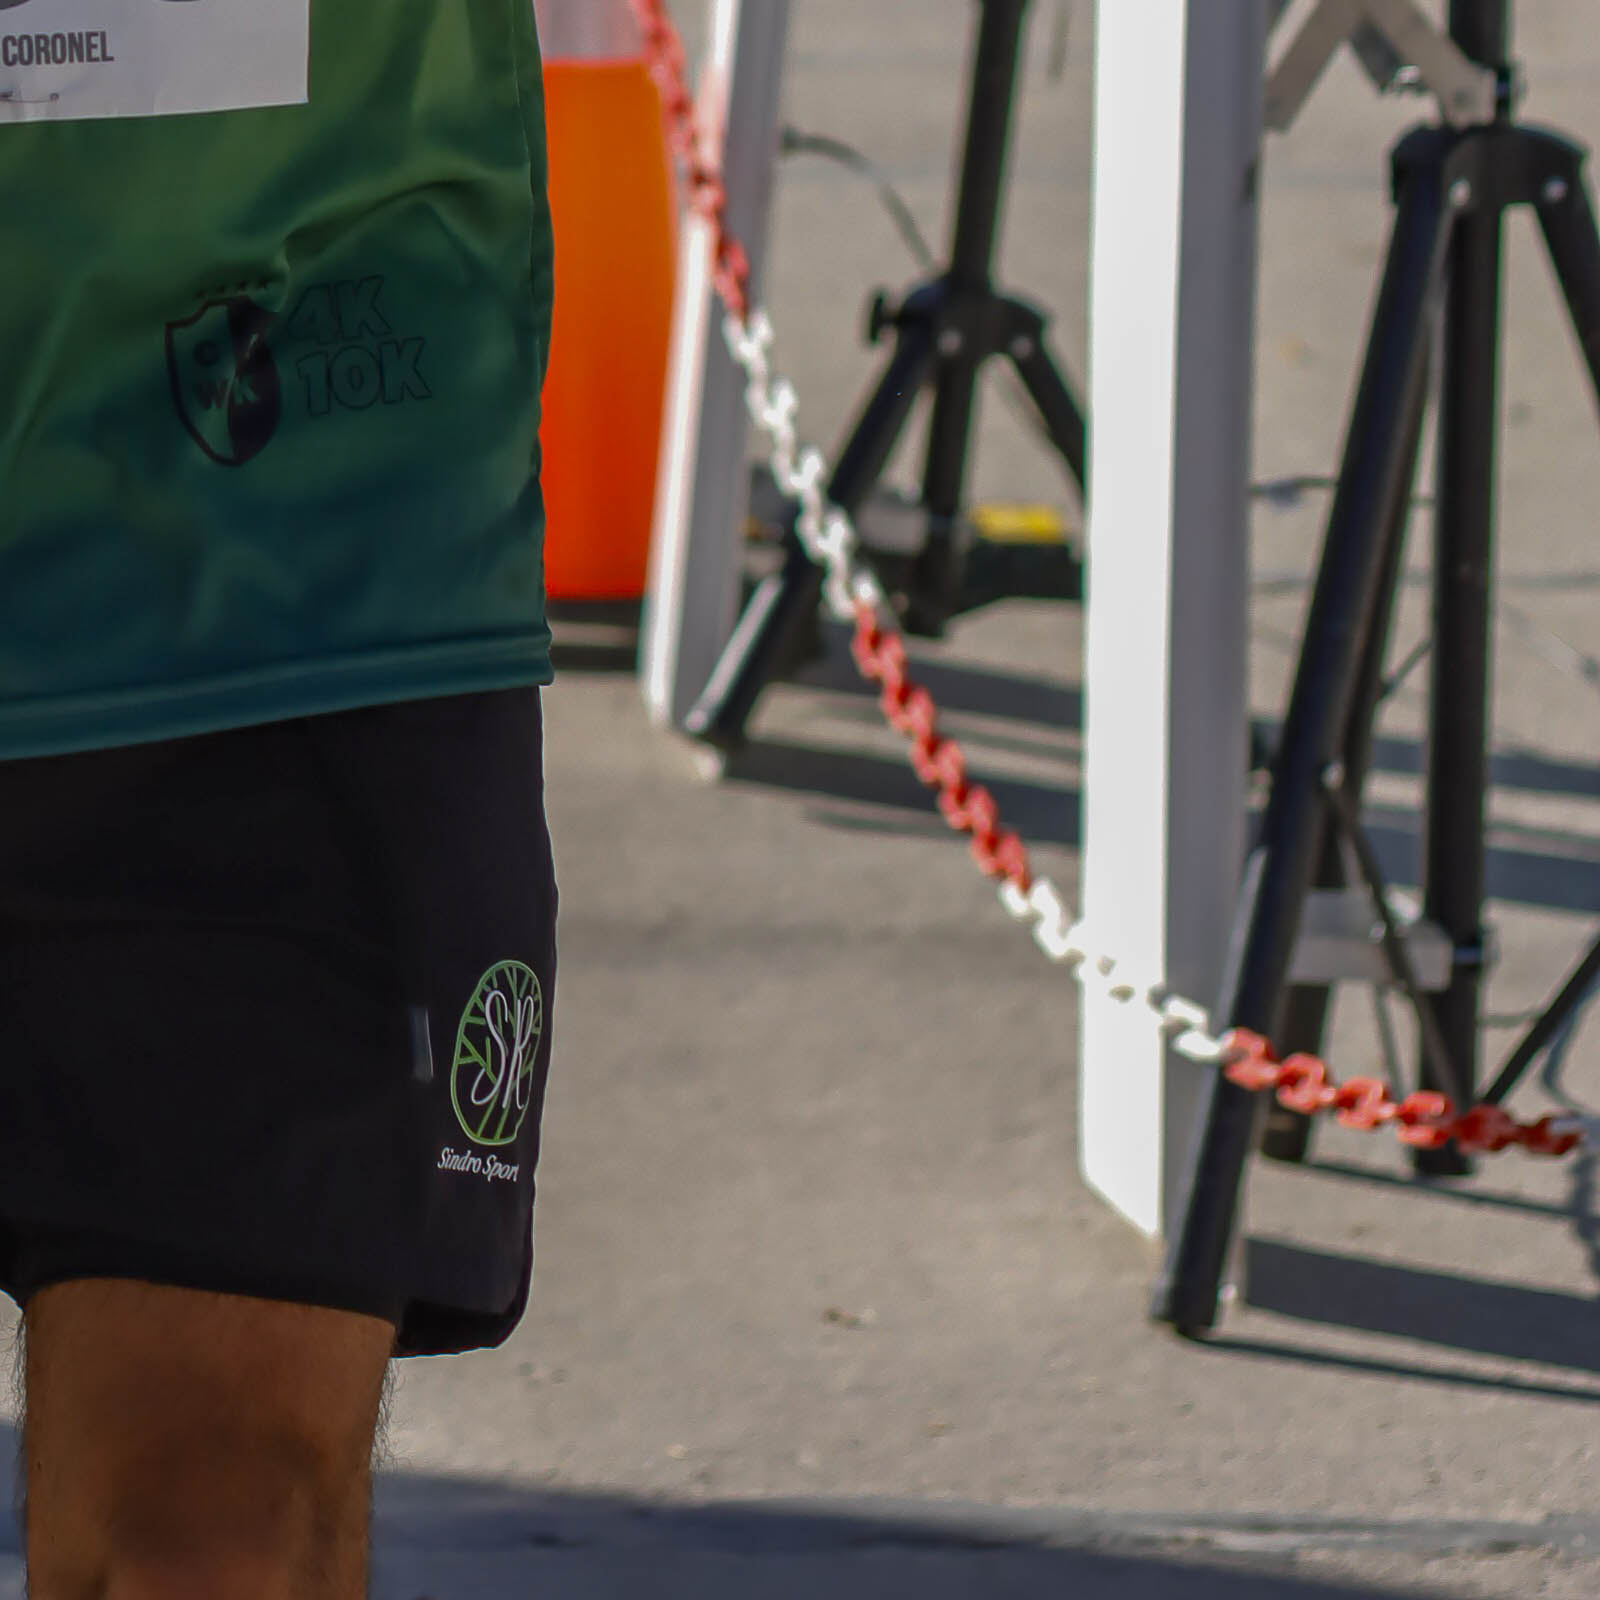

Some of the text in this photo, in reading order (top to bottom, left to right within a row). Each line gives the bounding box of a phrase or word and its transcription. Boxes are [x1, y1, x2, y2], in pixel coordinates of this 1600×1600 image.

[2, 30, 115, 67] CORONEL
[296, 336, 433, 418] 10K
[436, 1146, 482, 1174] Sindro
